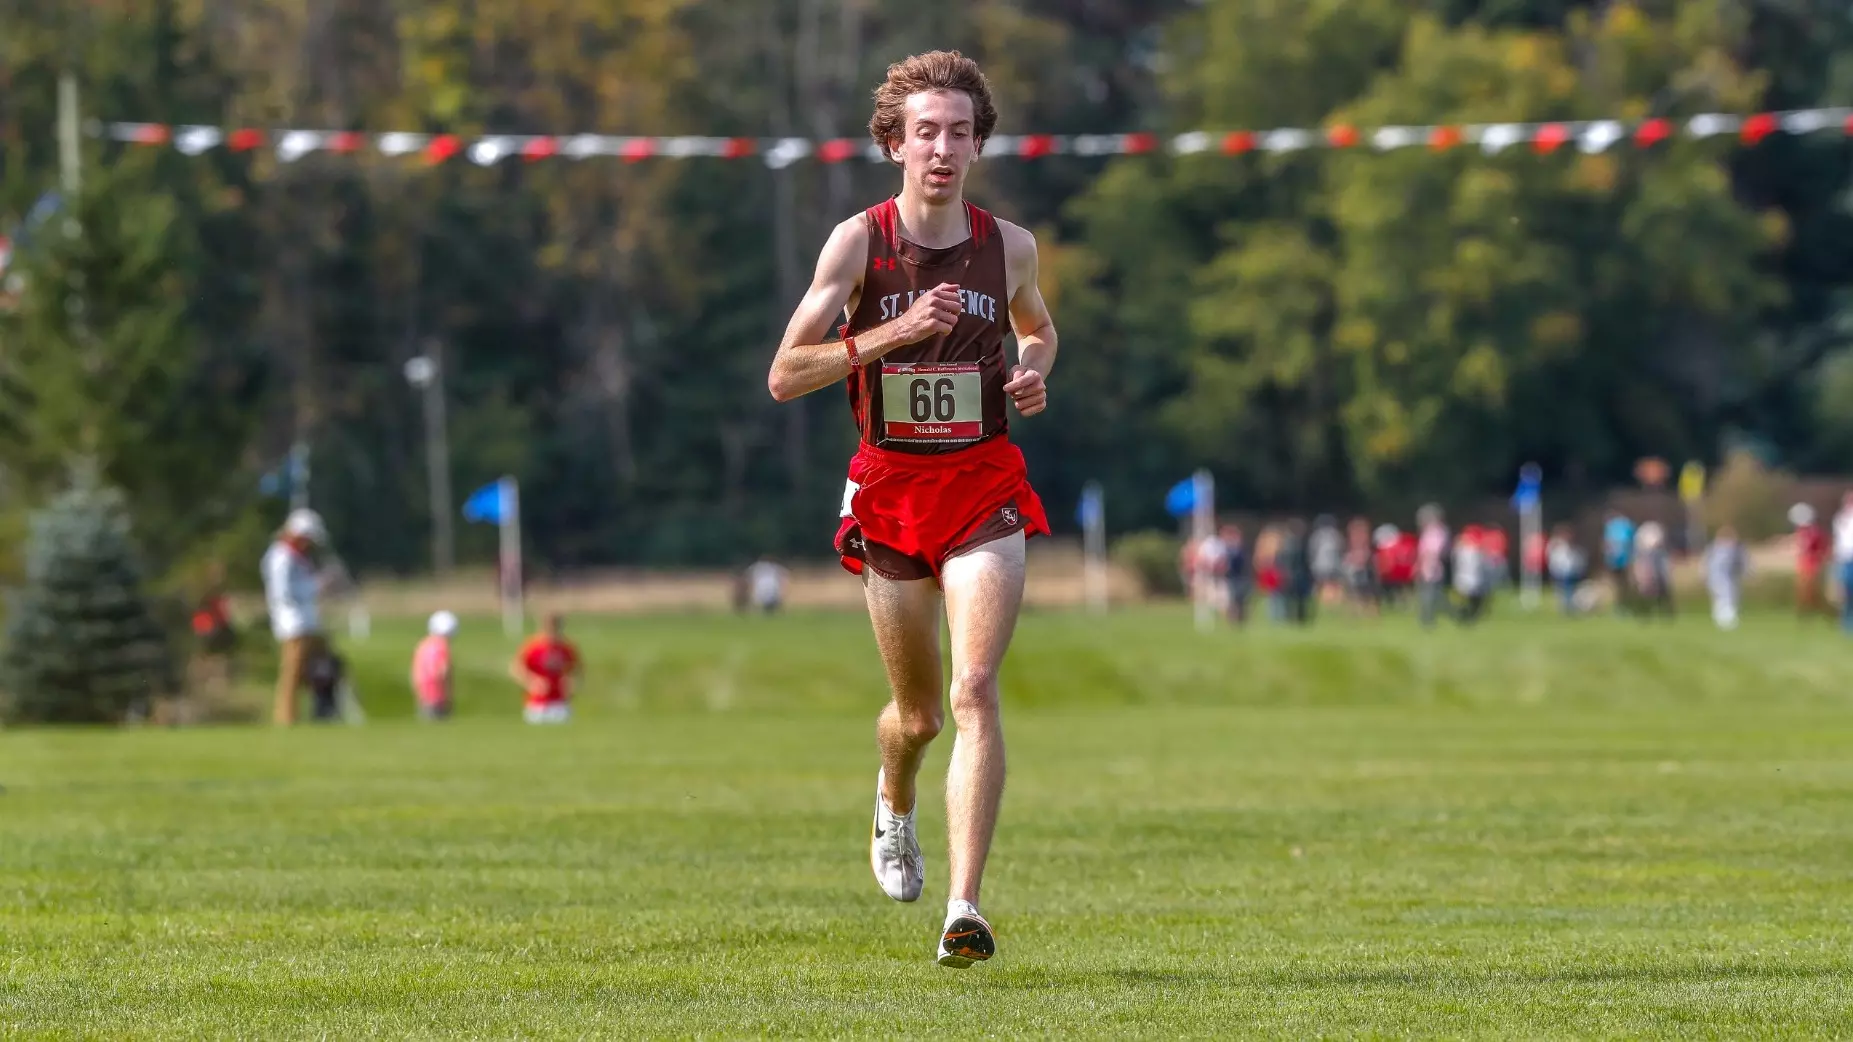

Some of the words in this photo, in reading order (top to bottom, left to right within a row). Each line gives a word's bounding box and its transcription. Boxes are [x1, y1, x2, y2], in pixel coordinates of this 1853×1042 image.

[880, 292, 903, 320] ST.
[907, 289, 996, 322] LENCE
[910, 377, 955, 422] 66
[914, 425, 952, 434] Nicholas
